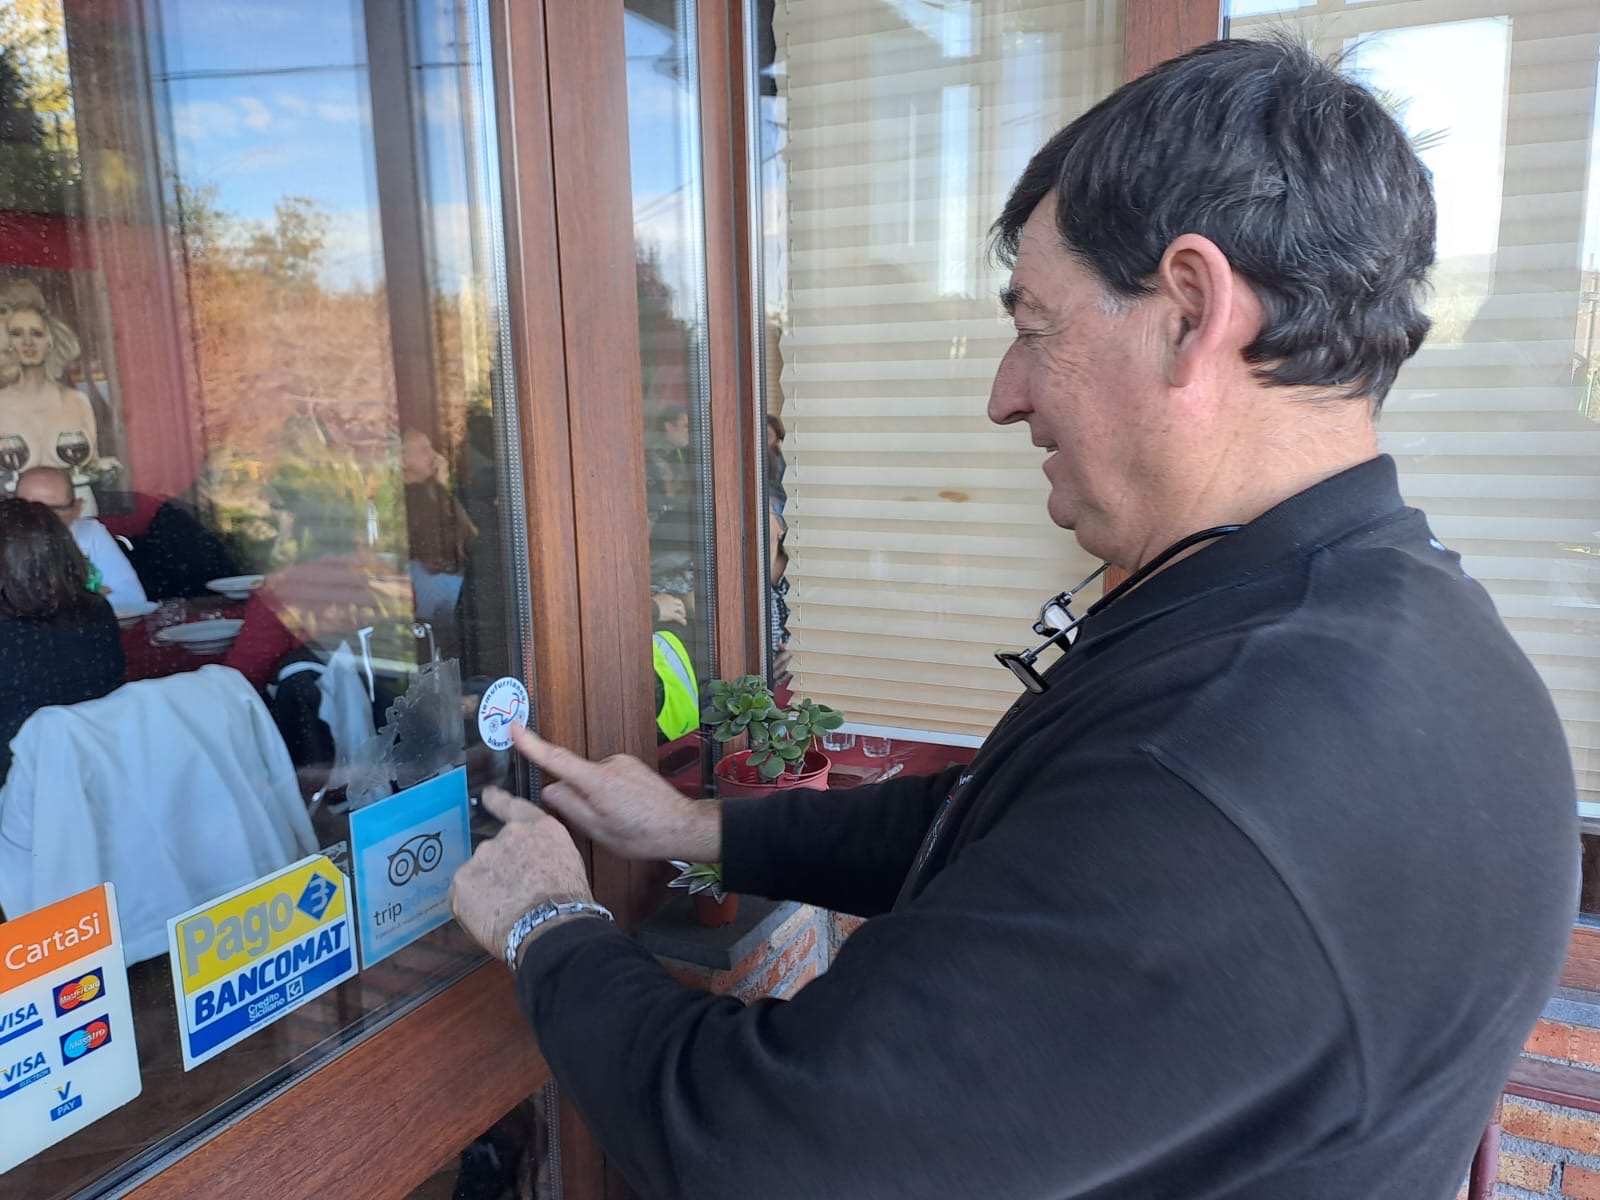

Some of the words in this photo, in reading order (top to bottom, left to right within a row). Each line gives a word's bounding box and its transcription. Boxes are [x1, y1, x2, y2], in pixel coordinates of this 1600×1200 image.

[5, 912, 100, 970] CartaSi
[182, 893, 294, 977] Pago
[195, 921, 346, 1026] BANCOMAT
[0, 1003, 39, 1033] VISA
[248, 993, 280, 1015] Credito
[249, 998, 286, 1022] Siciliano
[69, 1028, 106, 1051] Maestro
[3, 1051, 46, 1082] VISA
[57, 1100, 76, 1116] PAY
